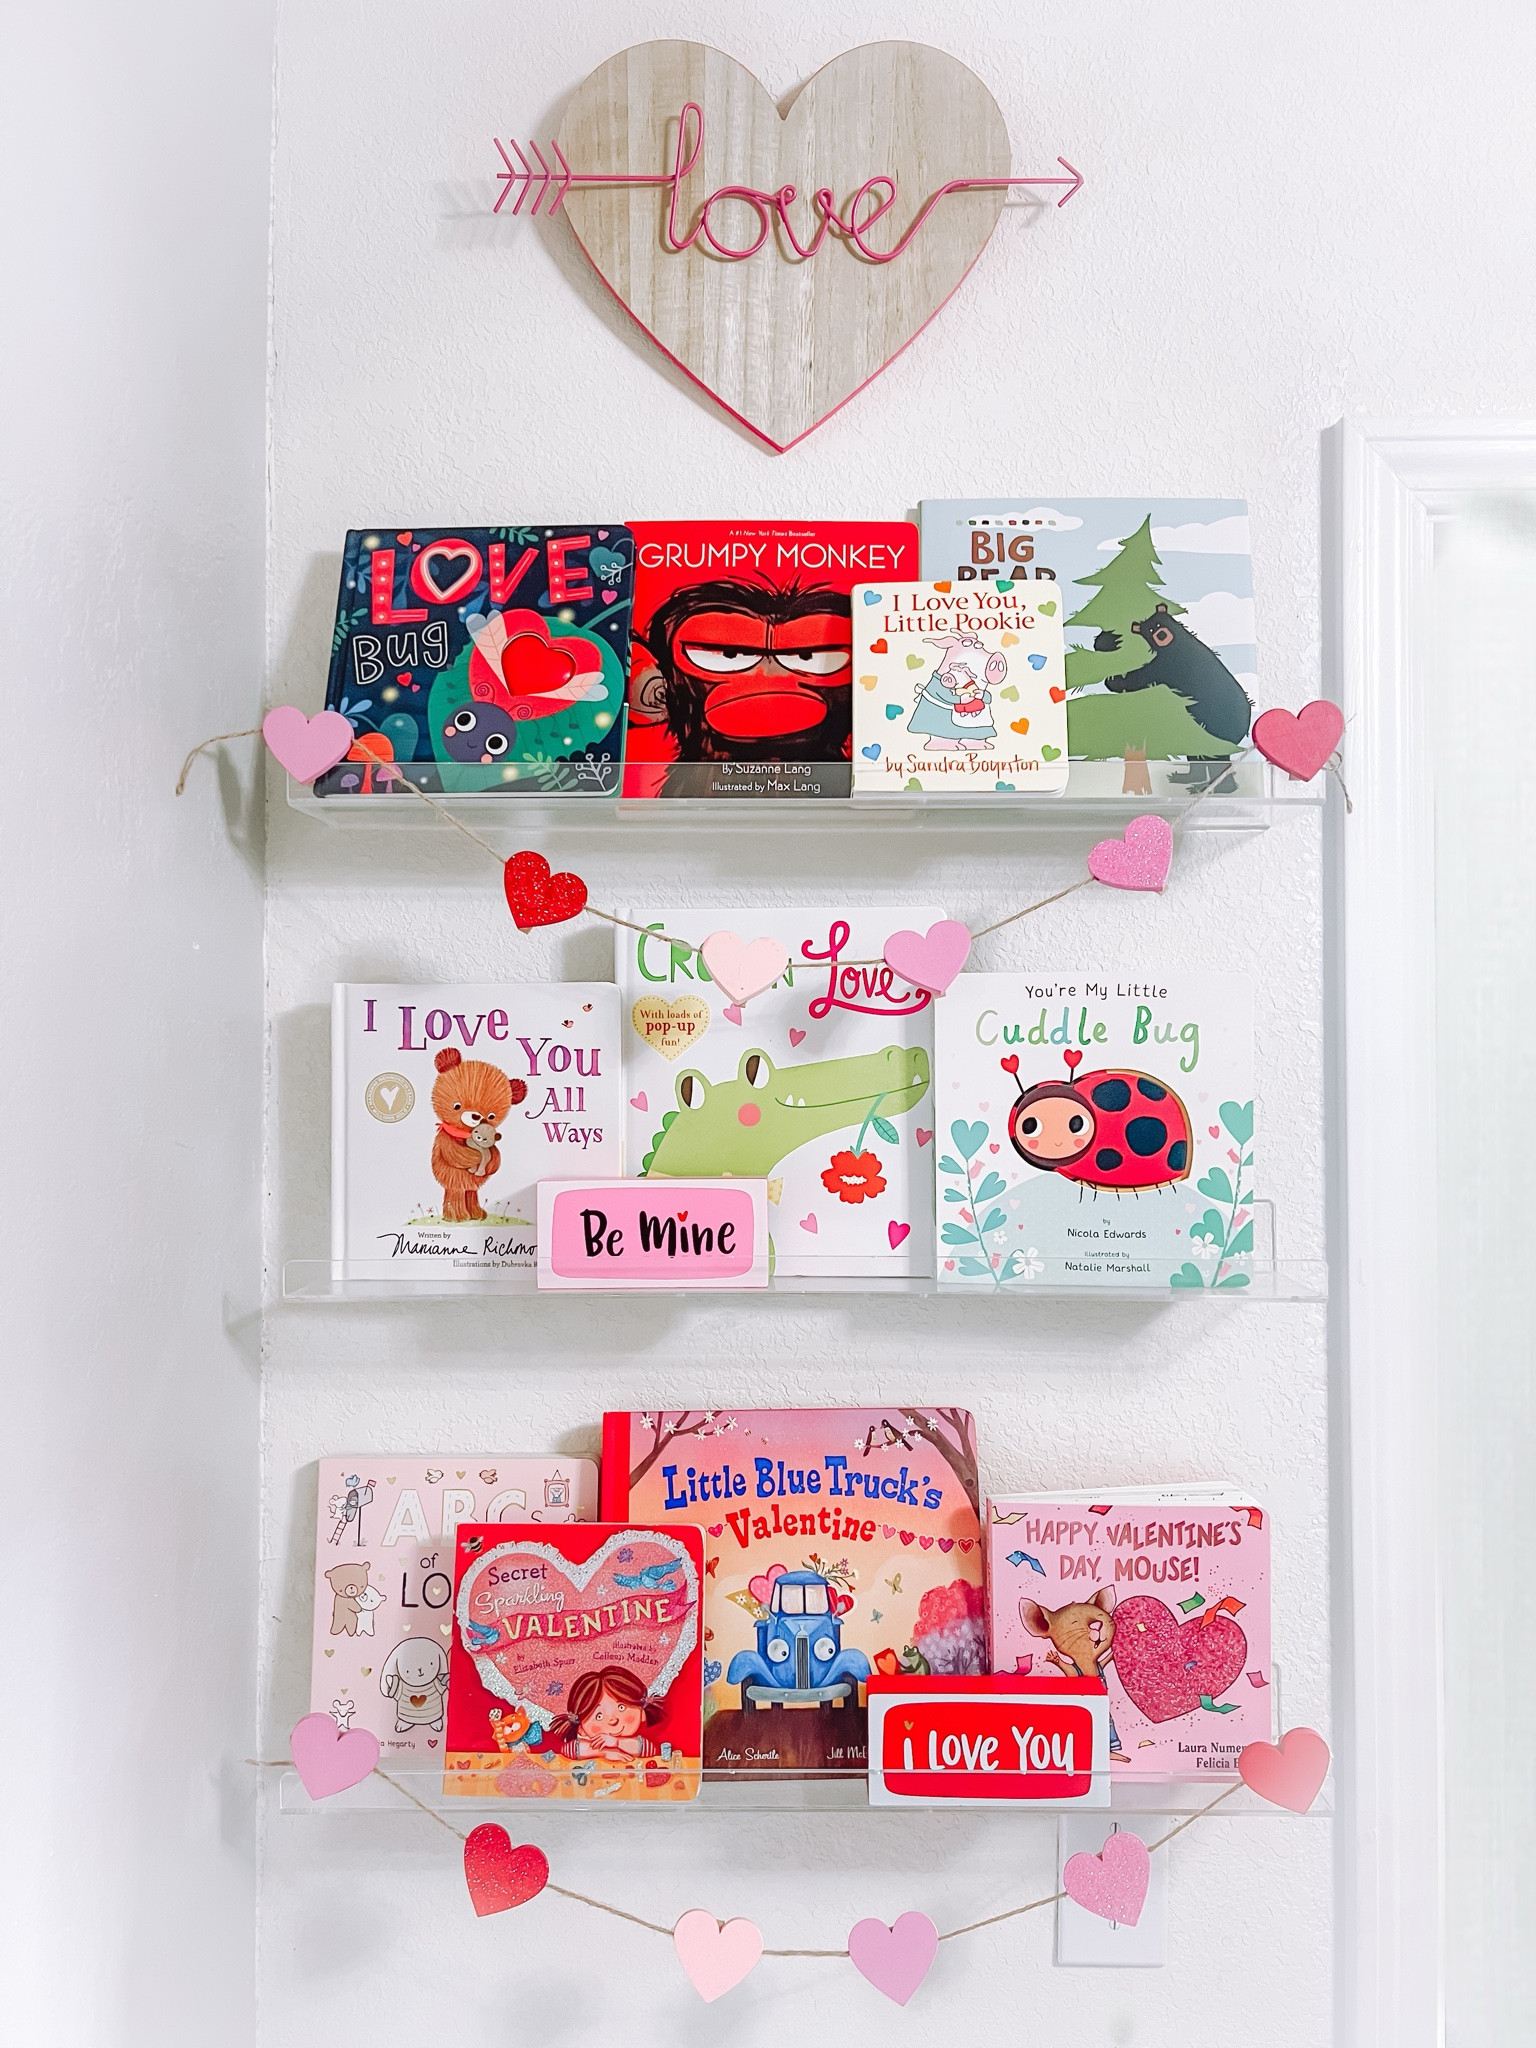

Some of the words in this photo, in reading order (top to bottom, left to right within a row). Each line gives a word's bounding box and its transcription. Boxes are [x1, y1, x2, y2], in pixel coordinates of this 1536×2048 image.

[668, 101, 915, 261] love
[638, 542, 768, 569] GRUMPY
[777, 543, 906, 570] MONKEY
[970, 530, 1035, 565] BIG
[370, 535, 594, 625] LOVE
[892, 594, 901, 612] I
[911, 593, 970, 612] Love
[973, 591, 1027, 612] You,
[884, 613, 948, 633] Little
[955, 611, 1036, 632] Pookie
[722, 763, 733, 776] By
[735, 763, 781, 774] Suzanne
[784, 763, 812, 777] Lang
[886, 755, 904, 779] by
[906, 753, 966, 774] Sandra
[965, 752, 1040, 780] Boynton
[712, 781, 753, 791] Illustrated
[754, 782, 766, 793] by
[767, 779, 791, 791] Max
[793, 779, 821, 794] Lang
[1025, 983, 1077, 999] You're
[1085, 982, 1108, 1001] My
[1117, 983, 1168, 999] Little
[639, 1009, 665, 1019] With
[667, 1009, 691, 1019] loads
[693, 1009, 704, 1019] of
[363, 999, 378, 1032] I
[397, 1005, 510, 1051] Love
[645, 1021, 696, 1036] pop-up
[661, 1037, 680, 1047] fun!
[975, 1006, 1109, 1046] Cuddle
[1132, 1005, 1200, 1073] Bug
[515, 1037, 602, 1077] You
[524, 1086, 587, 1120] All
[542, 1122, 604, 1150] Ways
[1102, 1218, 1111, 1226] by
[417, 1231, 442, 1239] Written
[443, 1231, 452, 1240] by
[579, 1208, 625, 1257] Be
[639, 1210, 737, 1258] Mine
[1067, 1228, 1100, 1238] Nicola
[1103, 1229, 1147, 1239] Edwards
[376, 1233, 478, 1258] Marianne
[1121, 1251, 1130, 1259] by
[453, 1260, 491, 1268] Illustrations
[492, 1260, 501, 1269] by
[1065, 1261, 1102, 1272] Natalie
[1106, 1263, 1151, 1273] Marshall
[662, 1462, 747, 1511] Little
[754, 1457, 821, 1499] Blue
[825, 1455, 943, 1510] Truck's
[725, 1503, 877, 1549] Valentine
[1025, 1518, 1099, 1546] HAPPY
[1106, 1520, 1242, 1551] VALENTINE'S
[419, 1552, 440, 1570] of
[1059, 1554, 1102, 1583] DAY,
[1114, 1555, 1200, 1583] MOUSE!
[488, 1563, 549, 1587] Secret
[474, 1584, 565, 1619] Sparkling
[501, 1598, 674, 1640] VALENTINE
[516, 1653, 525, 1662] by
[592, 1650, 625, 1661] Colleen
[513, 1658, 550, 1675] Elizabeth
[387, 1740, 416, 1750] Hegarty
[717, 1747, 742, 1762] Alice
[826, 1745, 844, 1760] Jill
[1178, 1741, 1208, 1753] Laura
[1196, 1757, 1231, 1769] Felicia
